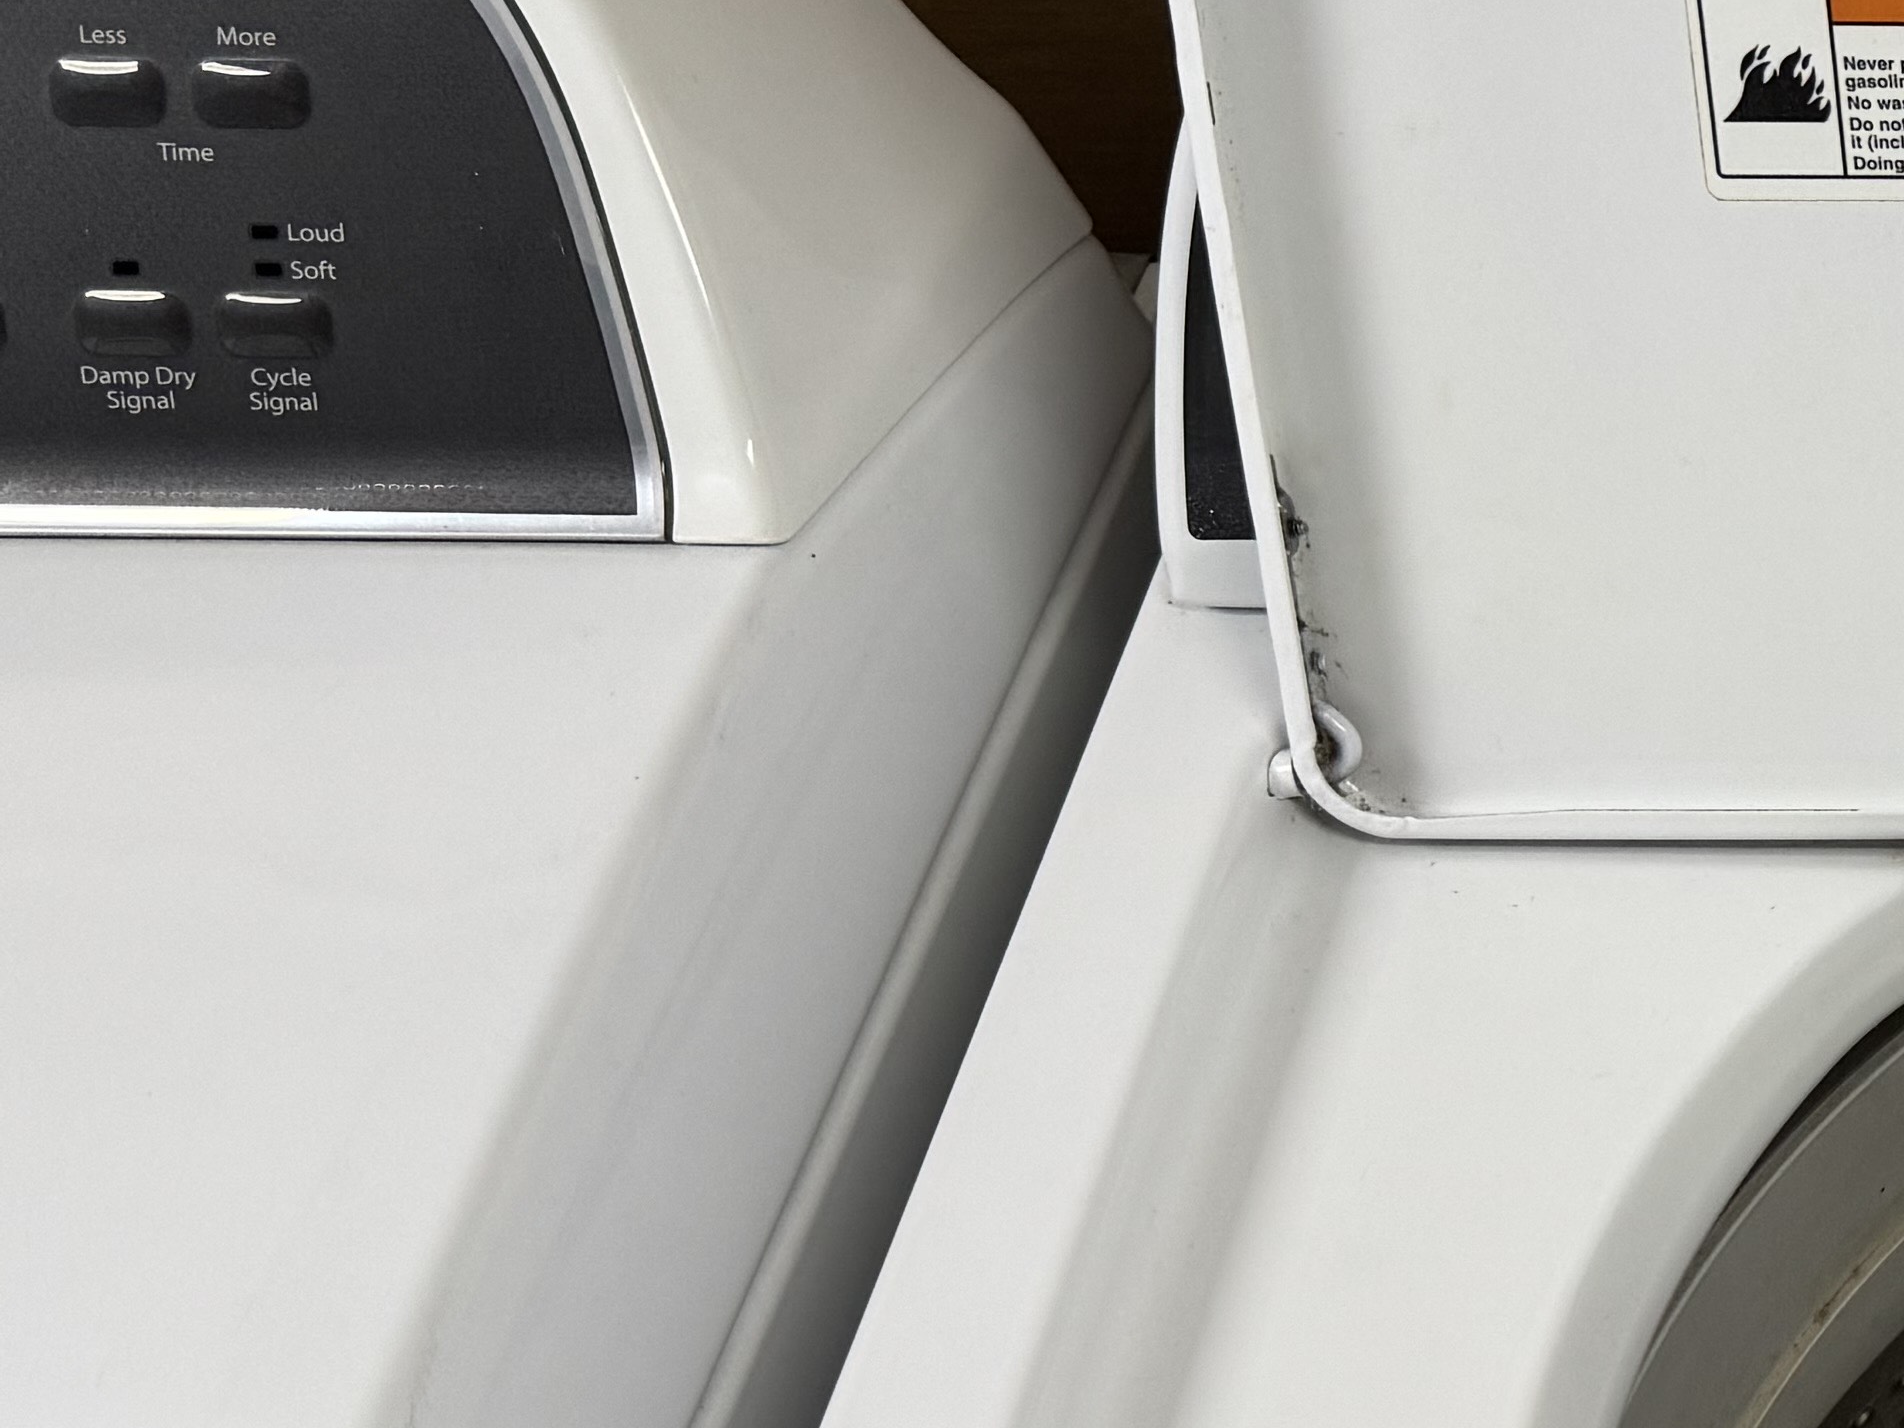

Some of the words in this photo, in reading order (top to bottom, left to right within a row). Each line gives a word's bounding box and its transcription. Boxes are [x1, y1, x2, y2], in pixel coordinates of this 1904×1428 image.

[80, 25, 126, 44] Less
[218, 27, 276, 46] More
[1848, 96, 1871, 110] No
[157, 142, 213, 161] Time
[288, 223, 344, 242] Loud
[291, 260, 336, 280] Soft
[80, 366, 149, 388] Damp
[156, 367, 195, 390] Dry
[251, 368, 311, 390] Cycle
[107, 388, 174, 414] Signal
[250, 388, 318, 415] Signal
